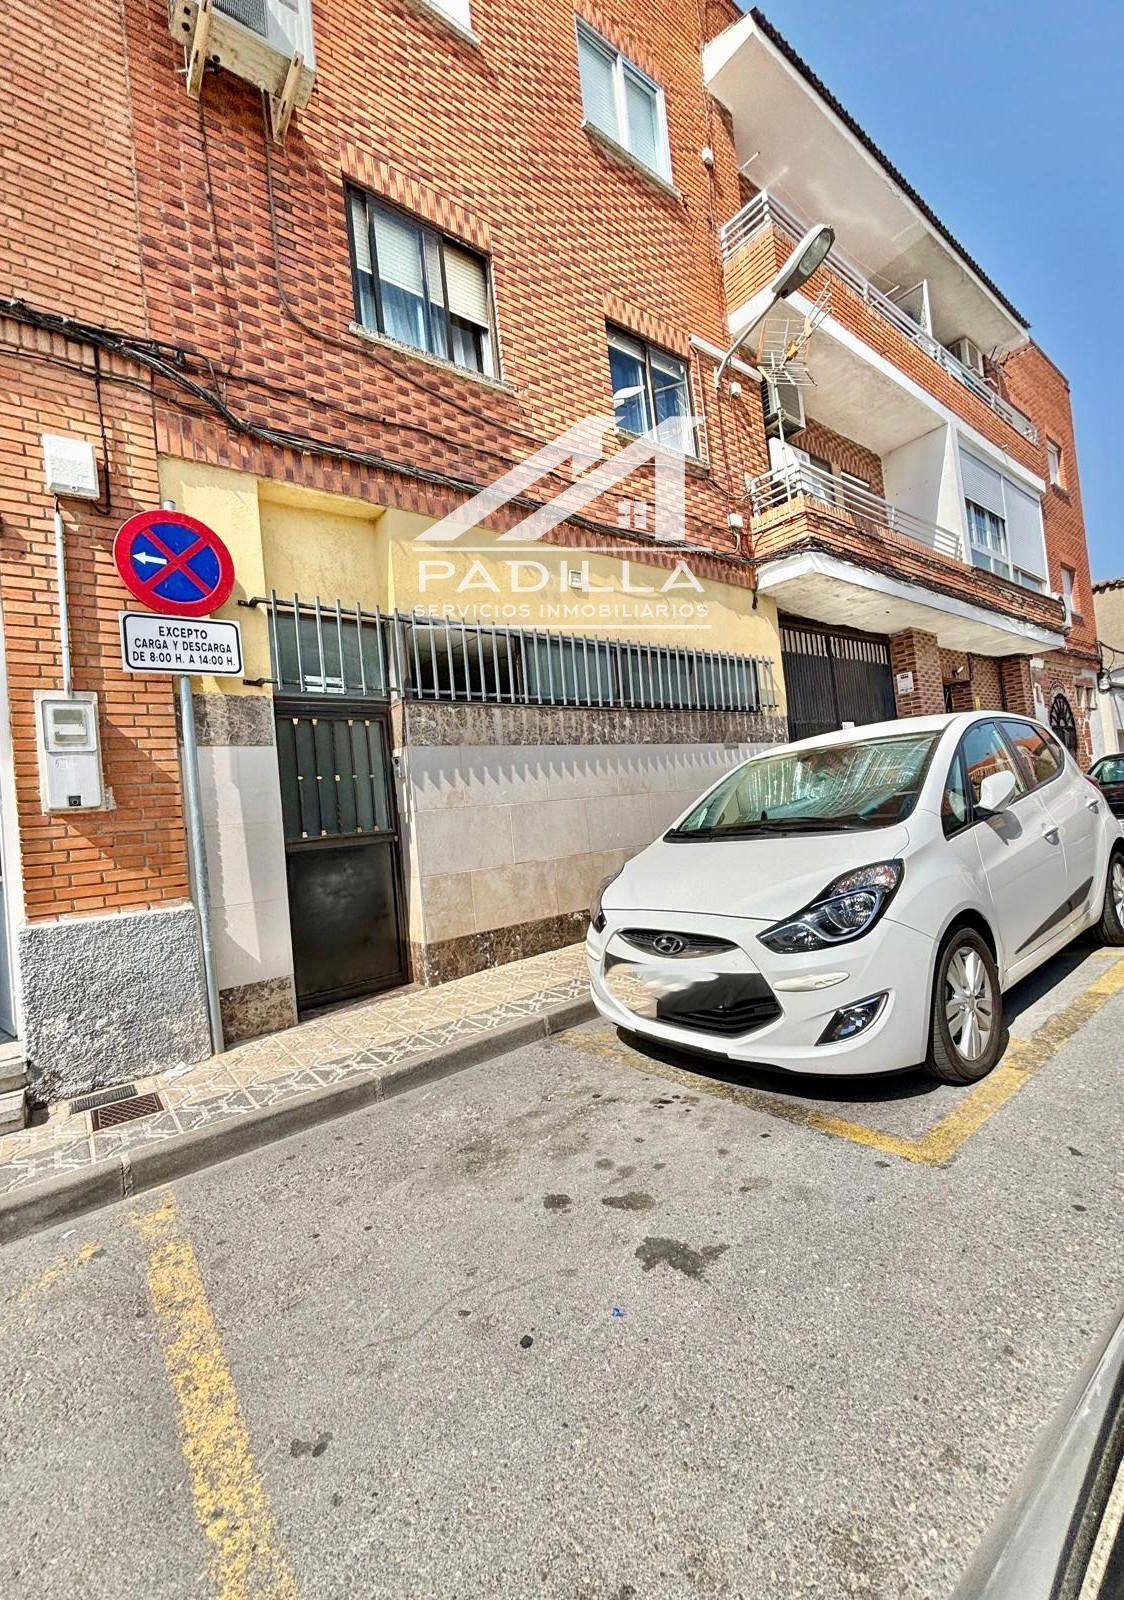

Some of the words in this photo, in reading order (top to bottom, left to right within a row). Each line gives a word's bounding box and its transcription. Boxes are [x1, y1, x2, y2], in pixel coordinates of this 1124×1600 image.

[158, 626, 208, 640] EXCEPTO
[134, 638, 168, 650] CARGA
[172, 640, 178, 650] Y
[182, 642, 231, 653] DESCARGA
[132, 651, 146, 662] DE
[149, 652, 172, 663] 8:00
[189, 654, 196, 665] A
[199, 655, 224, 666] 14:00
